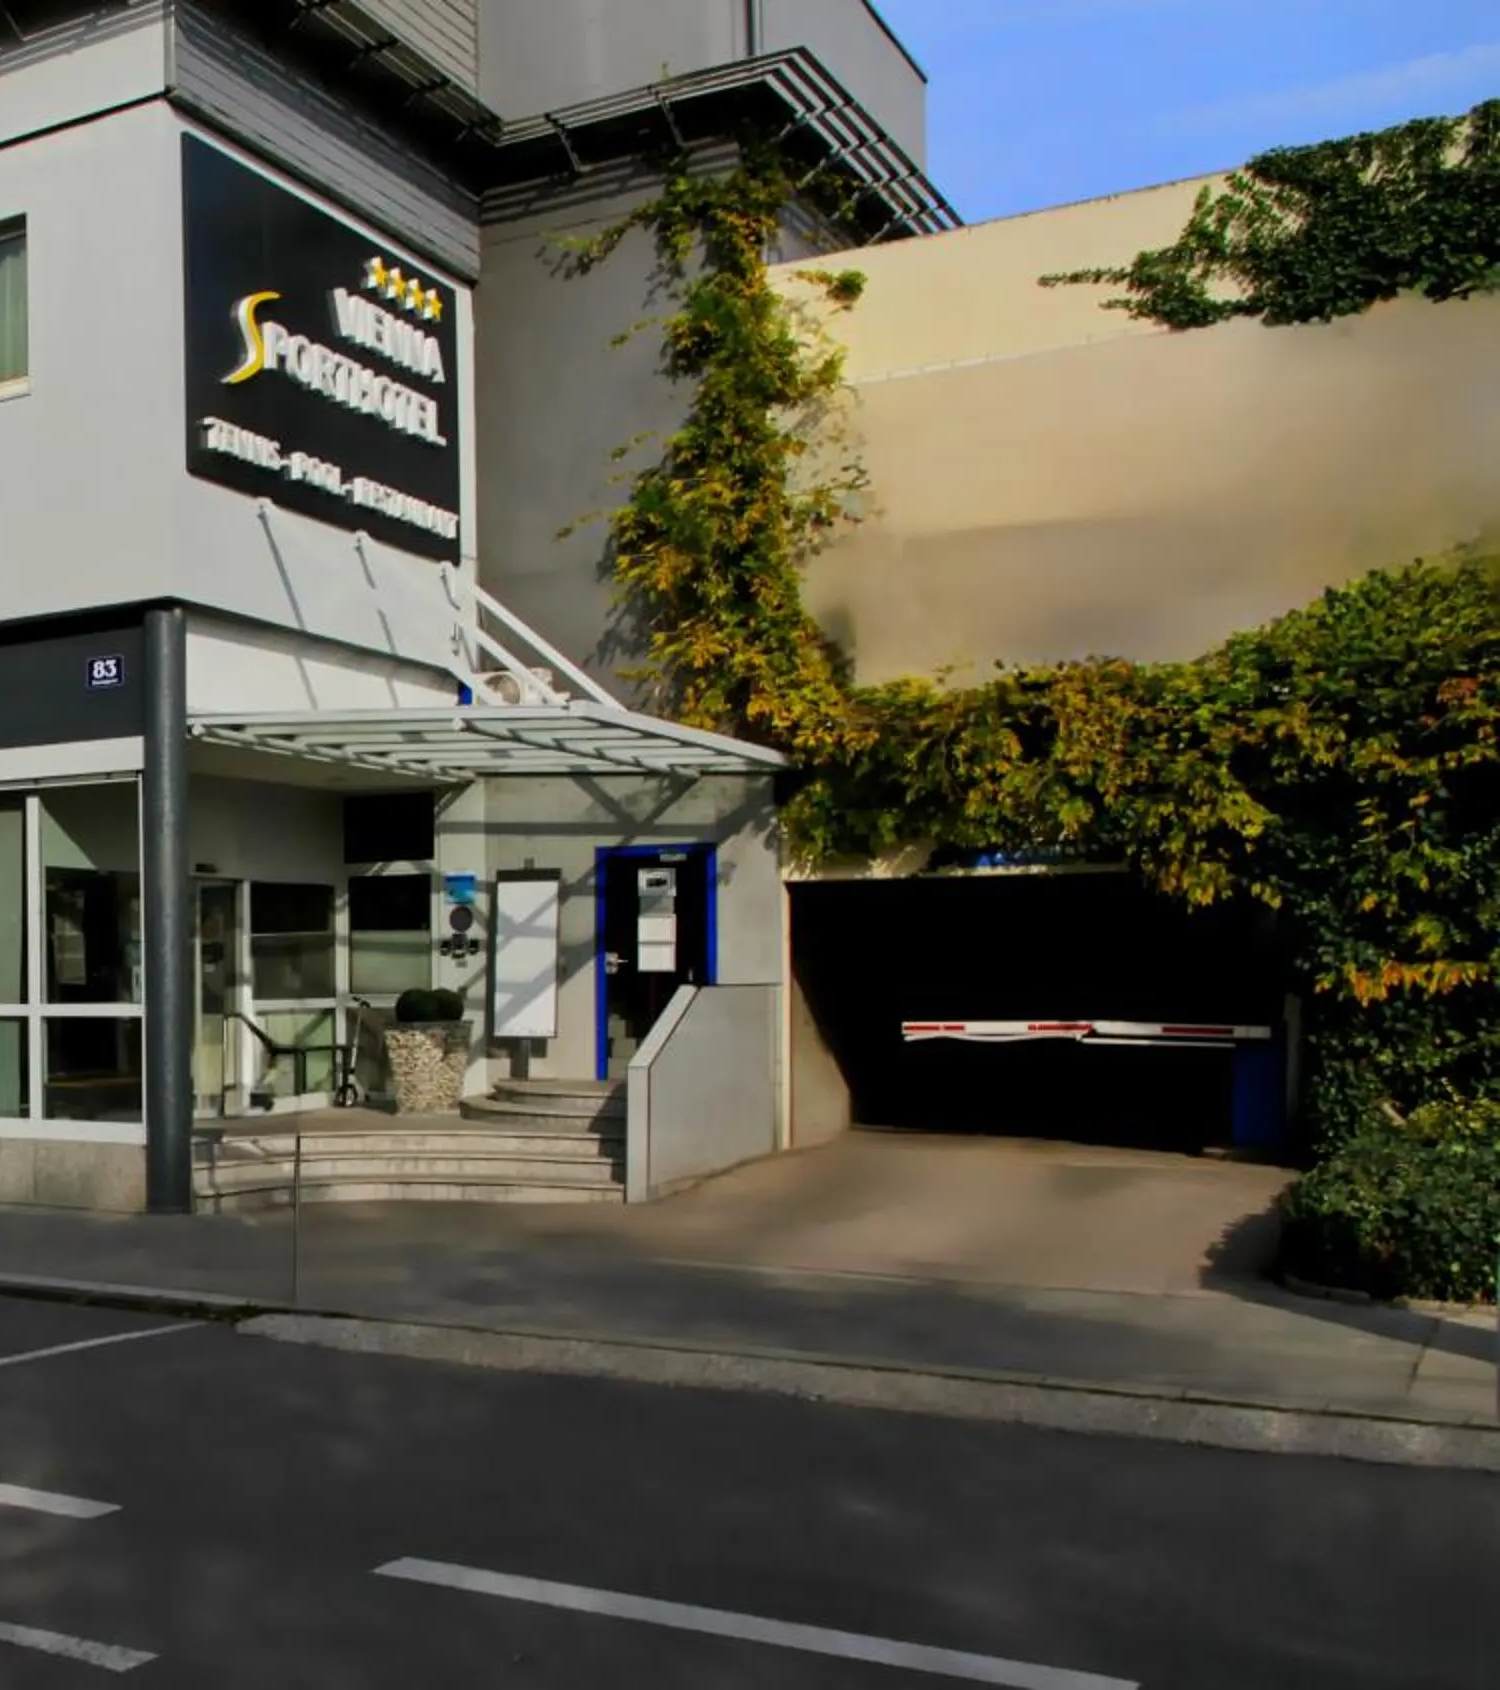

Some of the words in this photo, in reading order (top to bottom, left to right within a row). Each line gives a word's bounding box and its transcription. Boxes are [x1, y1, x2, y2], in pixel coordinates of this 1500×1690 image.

[221, 290, 447, 447] SPORTHOTEL
[332, 287, 446, 383] VIENNA
[93, 659, 117, 679] 83
